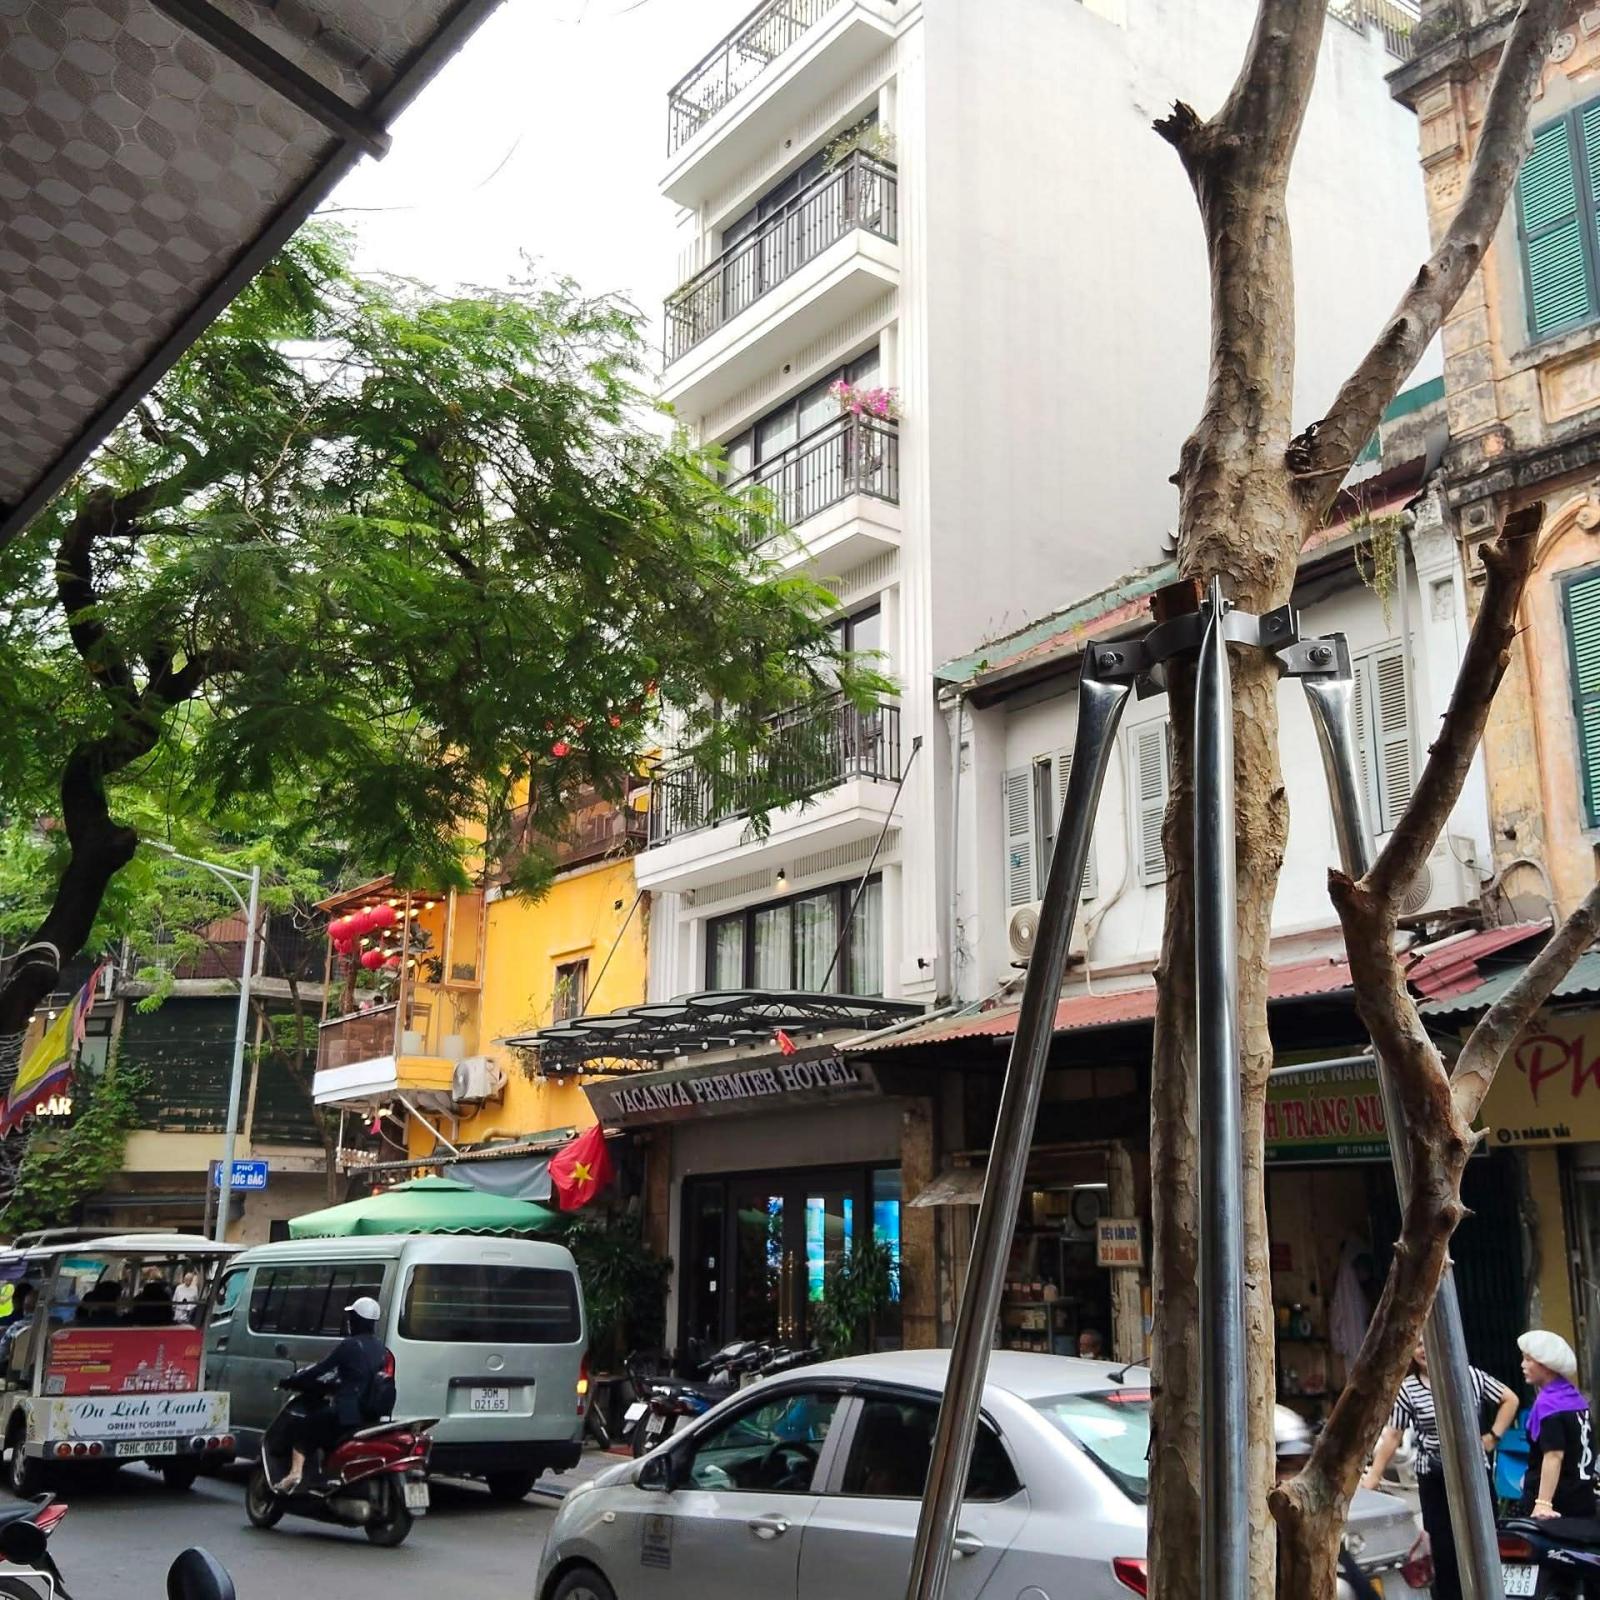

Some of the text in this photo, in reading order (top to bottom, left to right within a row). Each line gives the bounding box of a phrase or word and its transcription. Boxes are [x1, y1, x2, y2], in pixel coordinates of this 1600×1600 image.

[610, 1056, 858, 1114] VACANZA PREMIER HOTEL
[107, 1420, 176, 1431] GREEN TOURISM
